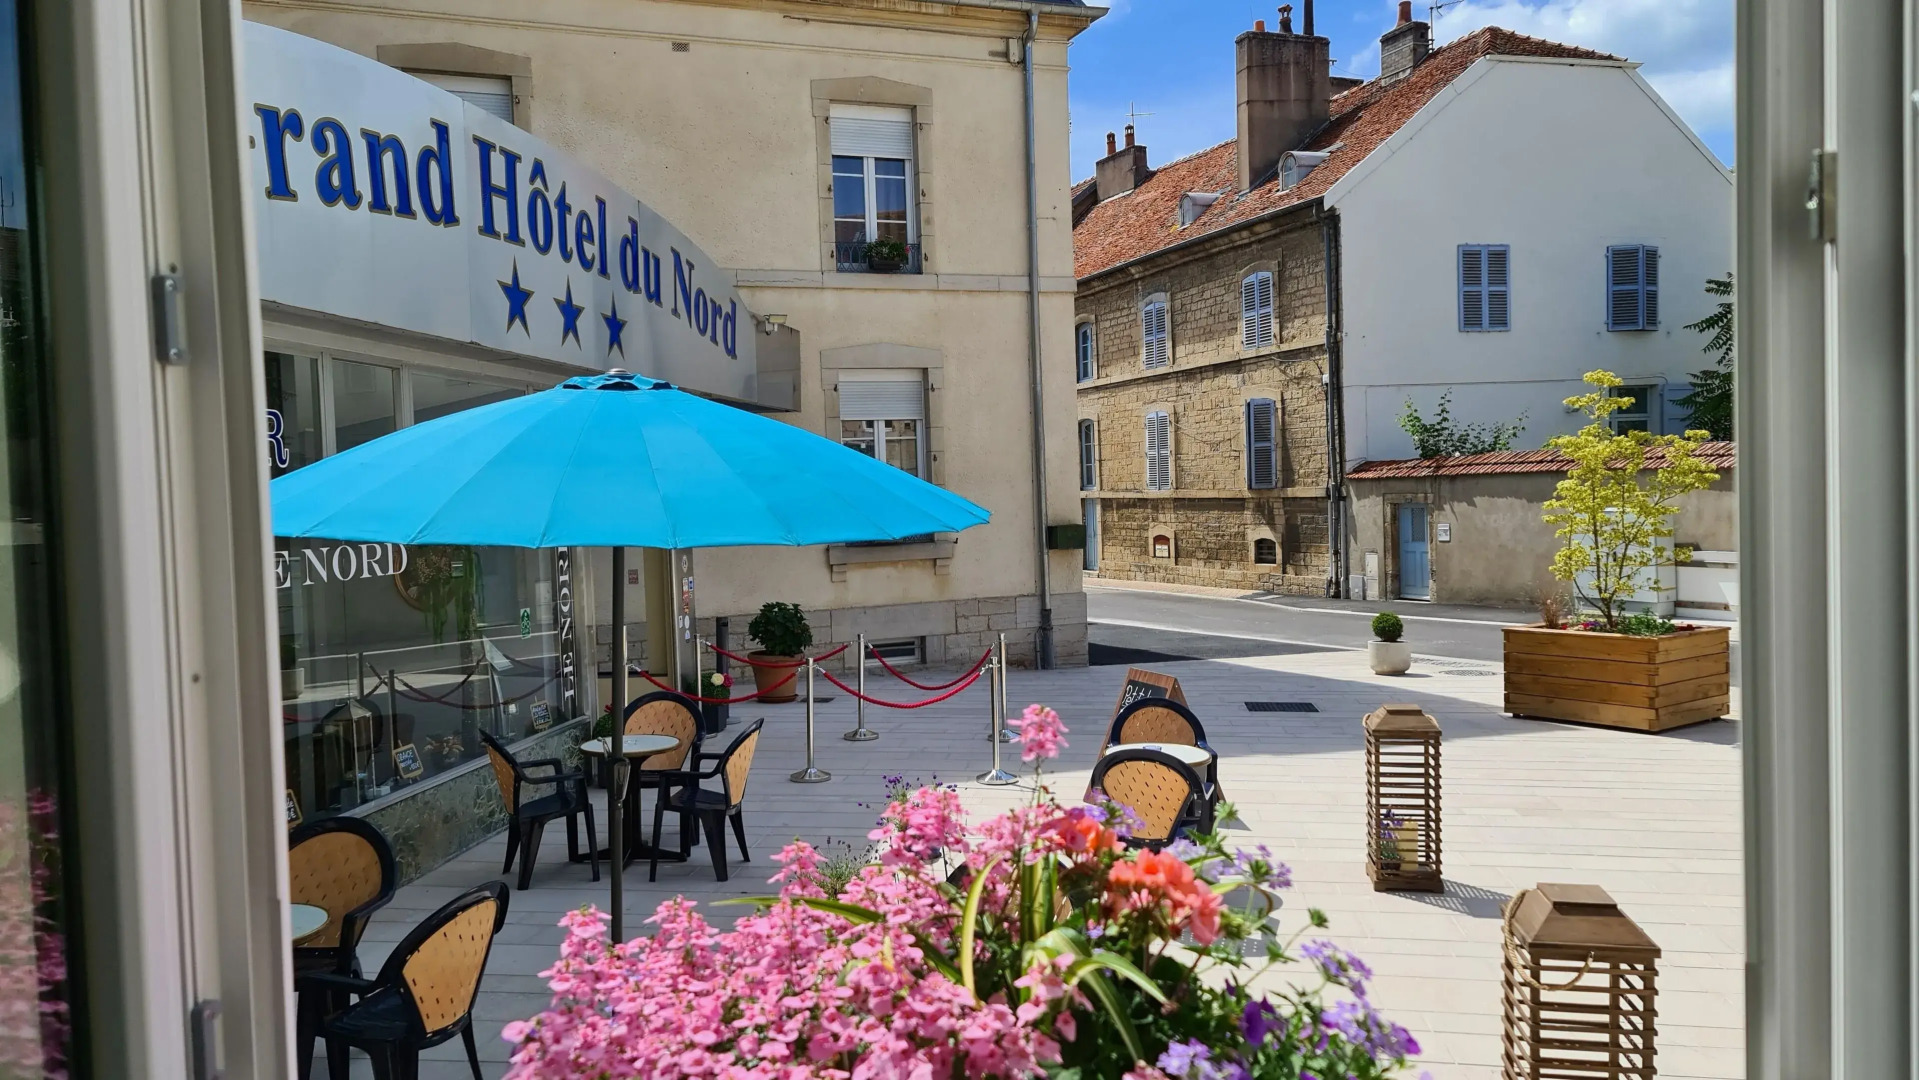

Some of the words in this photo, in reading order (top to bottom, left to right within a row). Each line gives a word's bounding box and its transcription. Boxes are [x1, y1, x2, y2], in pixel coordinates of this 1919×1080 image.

[249, 102, 460, 228] rand
[472, 134, 610, 280] Hôtel
[619, 215, 663, 308] du
[670, 246, 738, 360] Nord
[301, 542, 409, 586] NORD
[563, 651, 575, 701] LE
